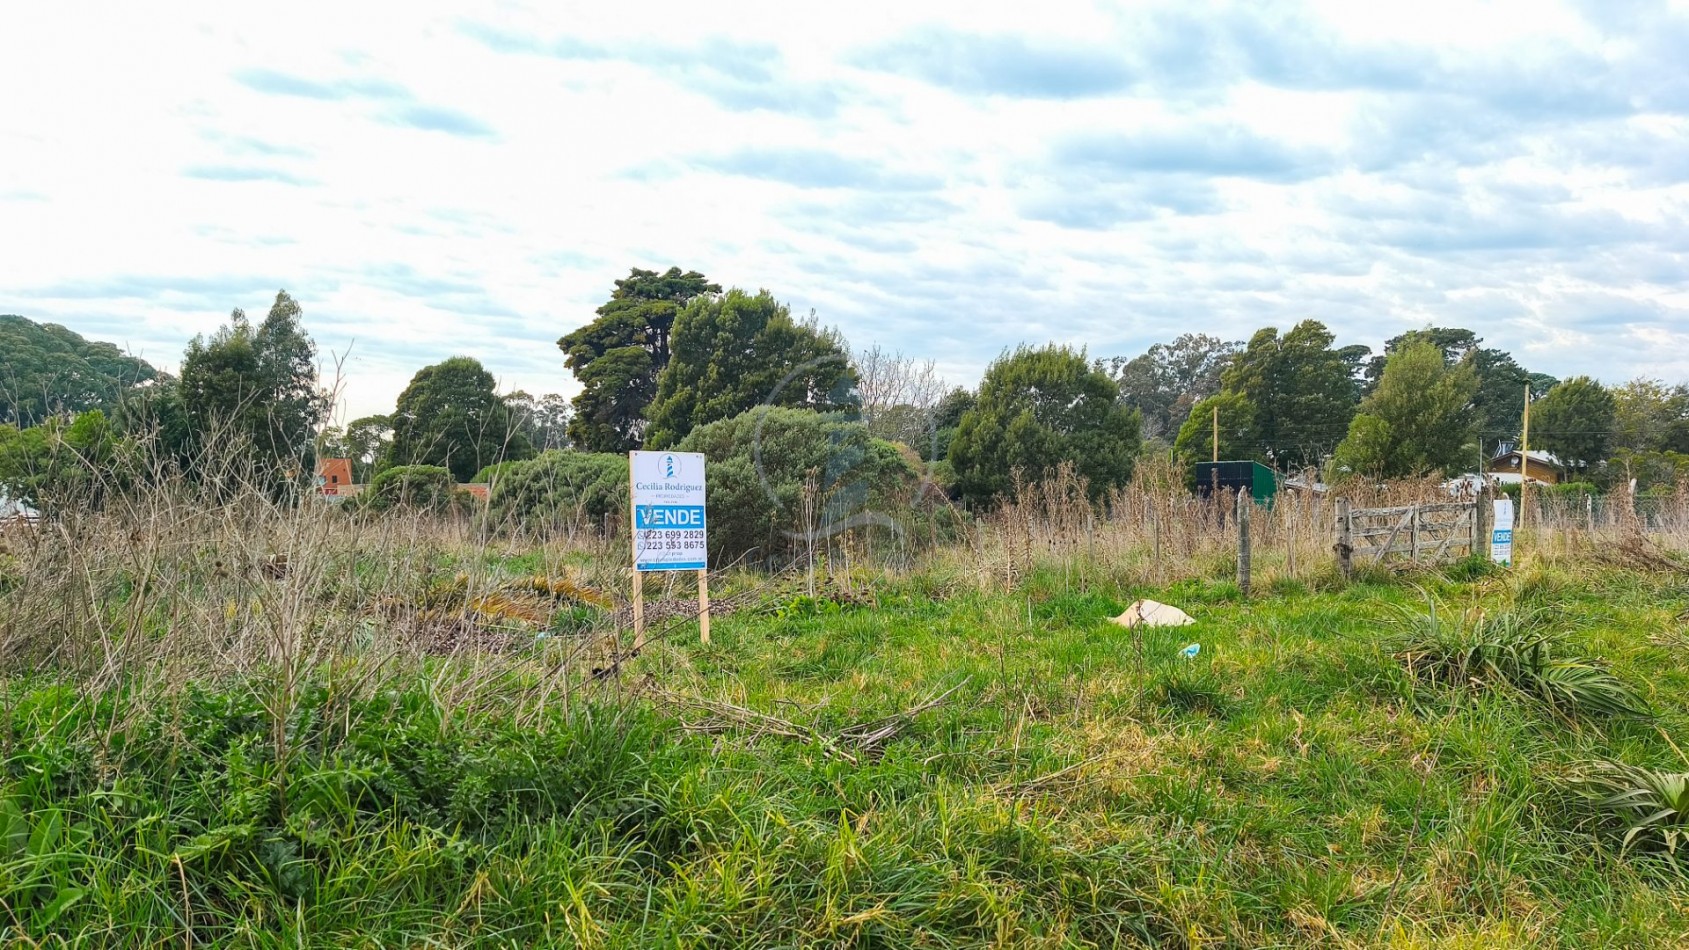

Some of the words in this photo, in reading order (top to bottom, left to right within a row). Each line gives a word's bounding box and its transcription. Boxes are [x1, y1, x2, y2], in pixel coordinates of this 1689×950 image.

[636, 482, 663, 491] Cecilia
[640, 509, 701, 525] VENDE
[646, 530, 663, 539] 223
[665, 530, 682, 539] 699
[683, 530, 704, 539] 2829
[646, 541, 663, 550] 223
[683, 541, 705, 550] 8675
